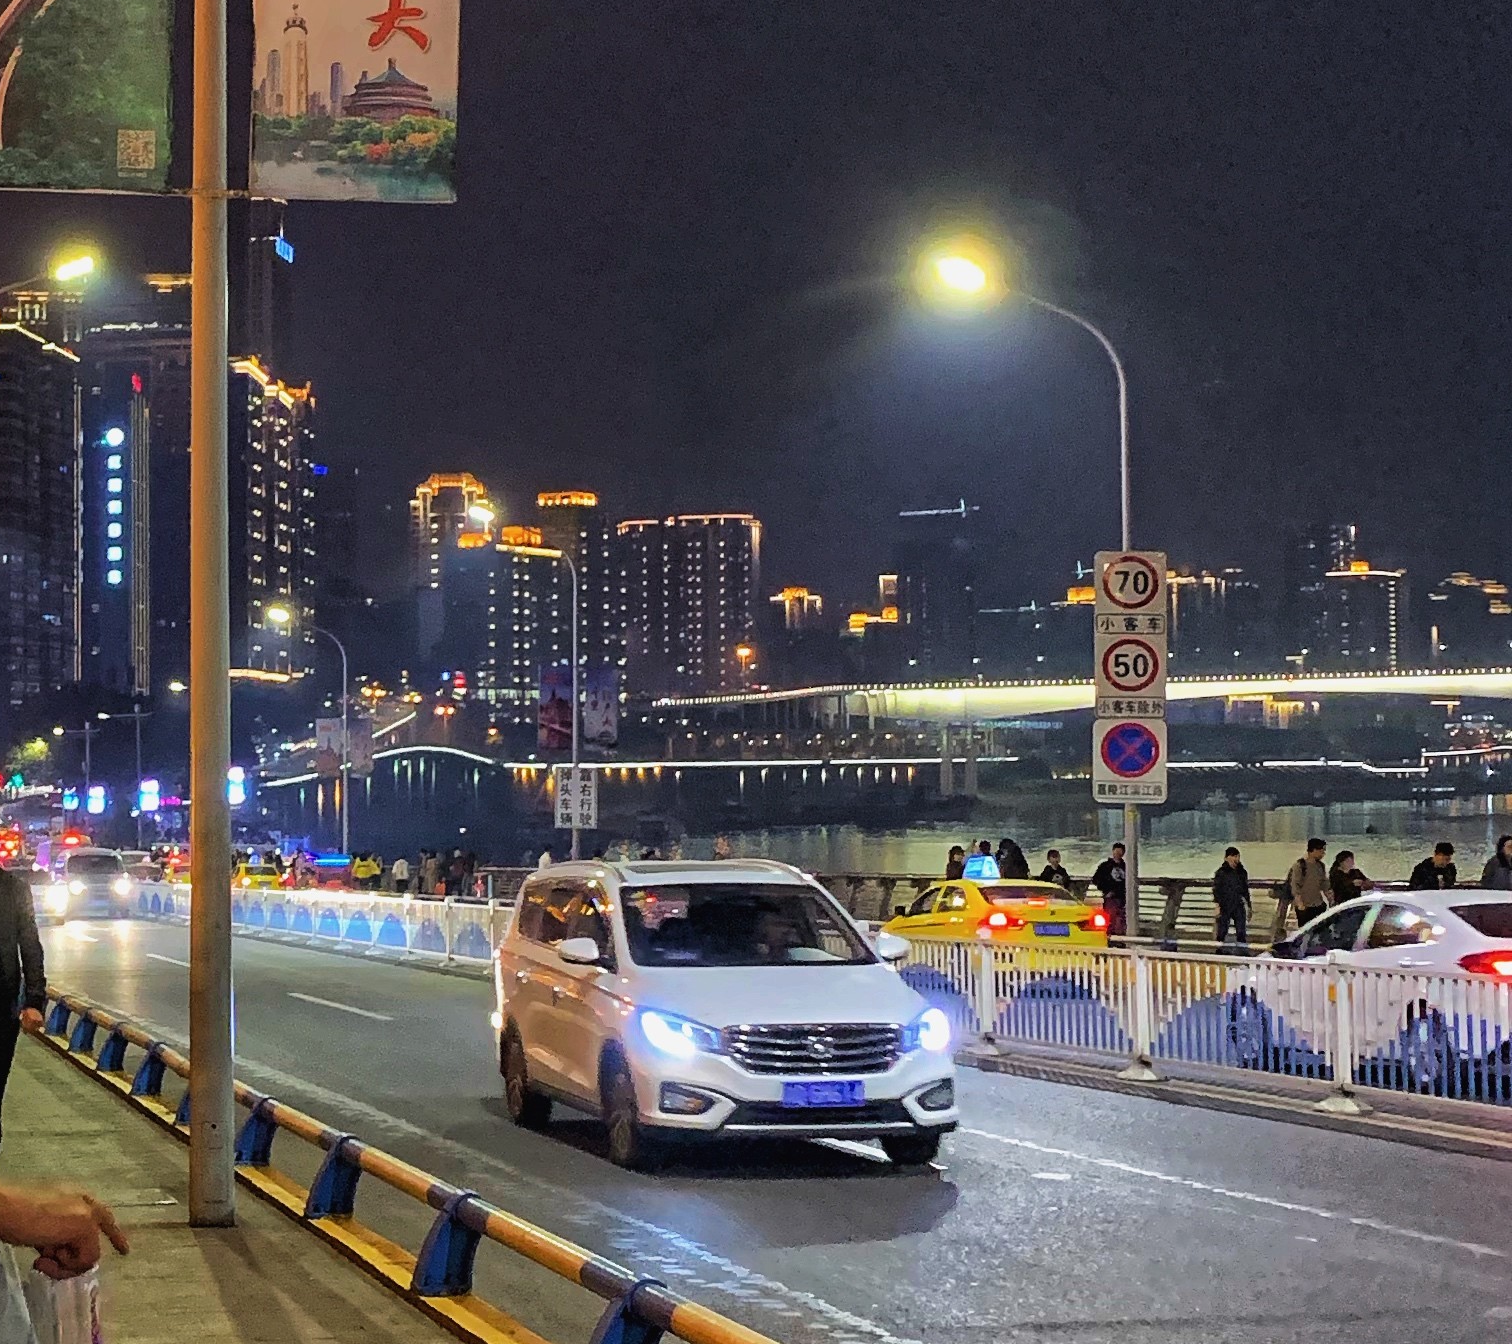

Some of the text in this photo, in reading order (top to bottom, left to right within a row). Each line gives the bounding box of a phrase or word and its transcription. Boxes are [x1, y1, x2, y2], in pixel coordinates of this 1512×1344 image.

[1114, 570, 1149, 596] 70
[1100, 616, 1162, 632] 小客车
[1113, 653, 1149, 678] 50
[1098, 700, 1163, 714] 小客车除外
